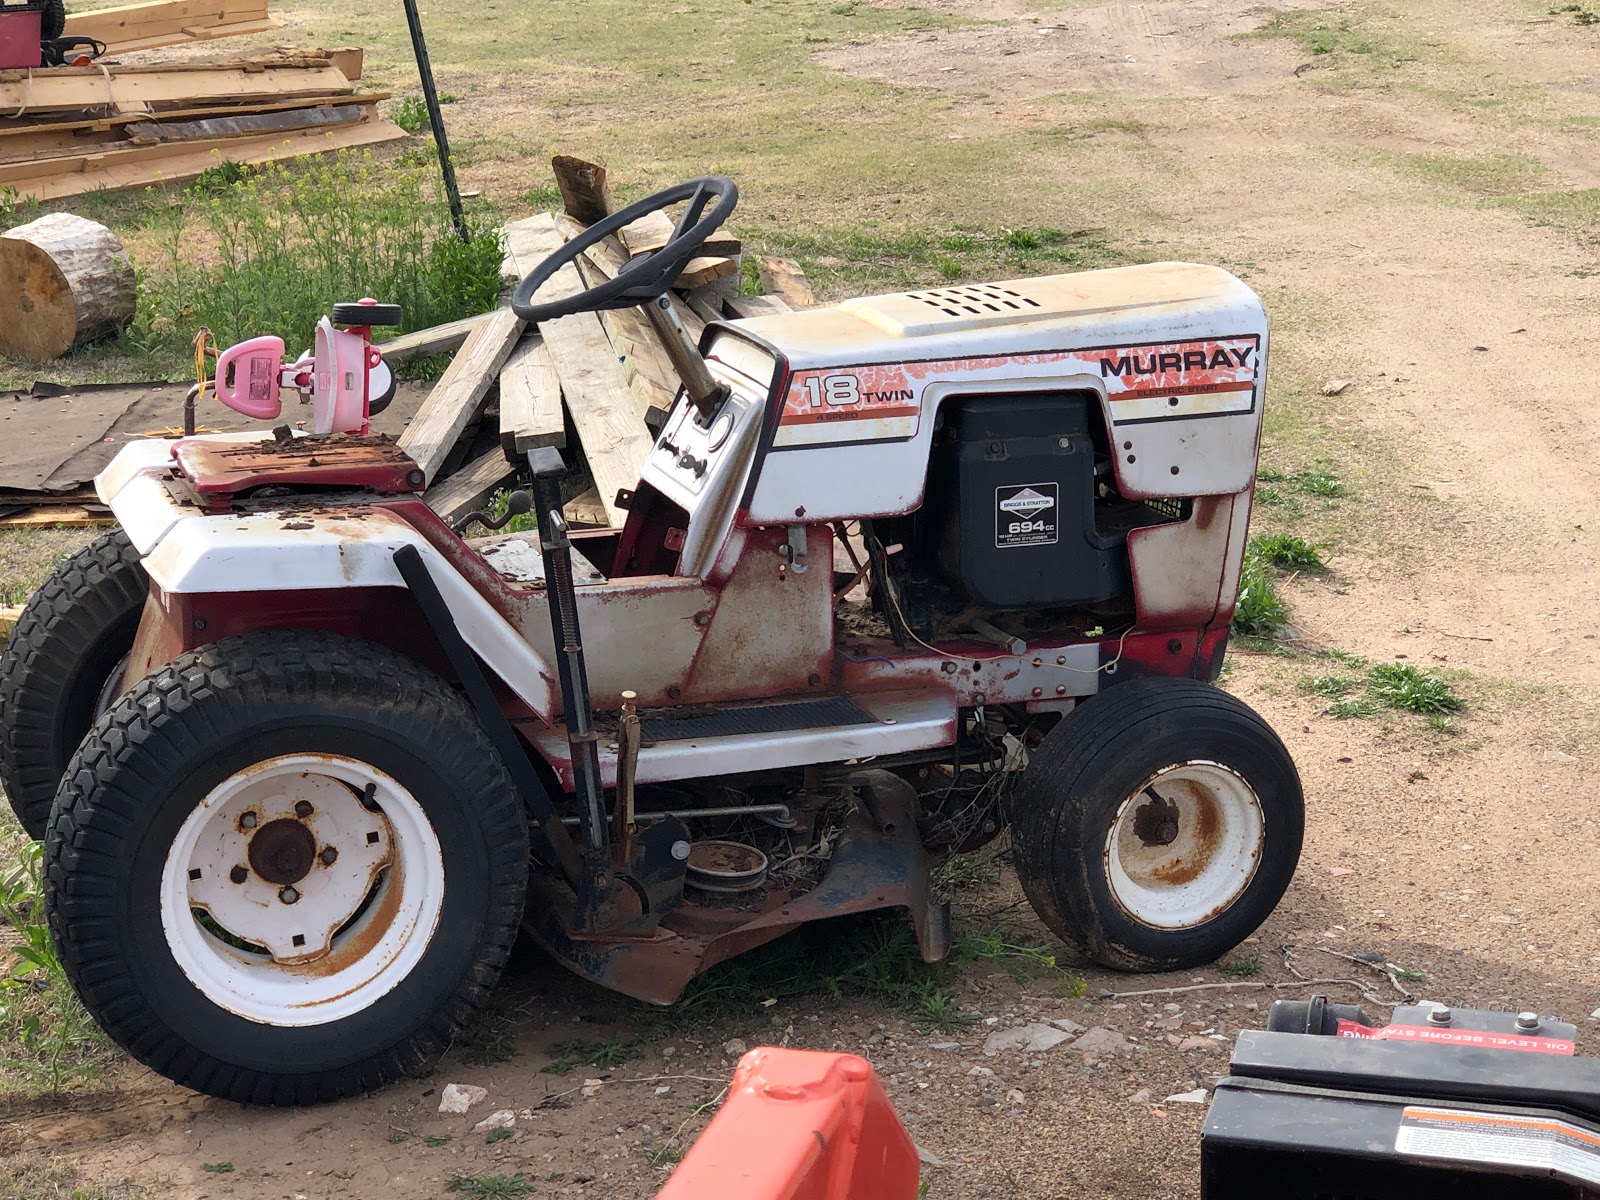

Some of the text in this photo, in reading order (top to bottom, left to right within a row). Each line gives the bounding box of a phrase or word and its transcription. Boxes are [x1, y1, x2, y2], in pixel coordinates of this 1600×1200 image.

[1099, 346, 1254, 378] MURRAY
[804, 374, 914, 407] 18 TWIN
[1137, 383, 1220, 397] ELECTRIC START
[826, 412, 859, 421] SPEED
[1419, 1031, 1483, 1043] BEFORE
[1488, 1037, 1537, 1048] LEVEL
[1542, 1042, 1568, 1051] OIL
